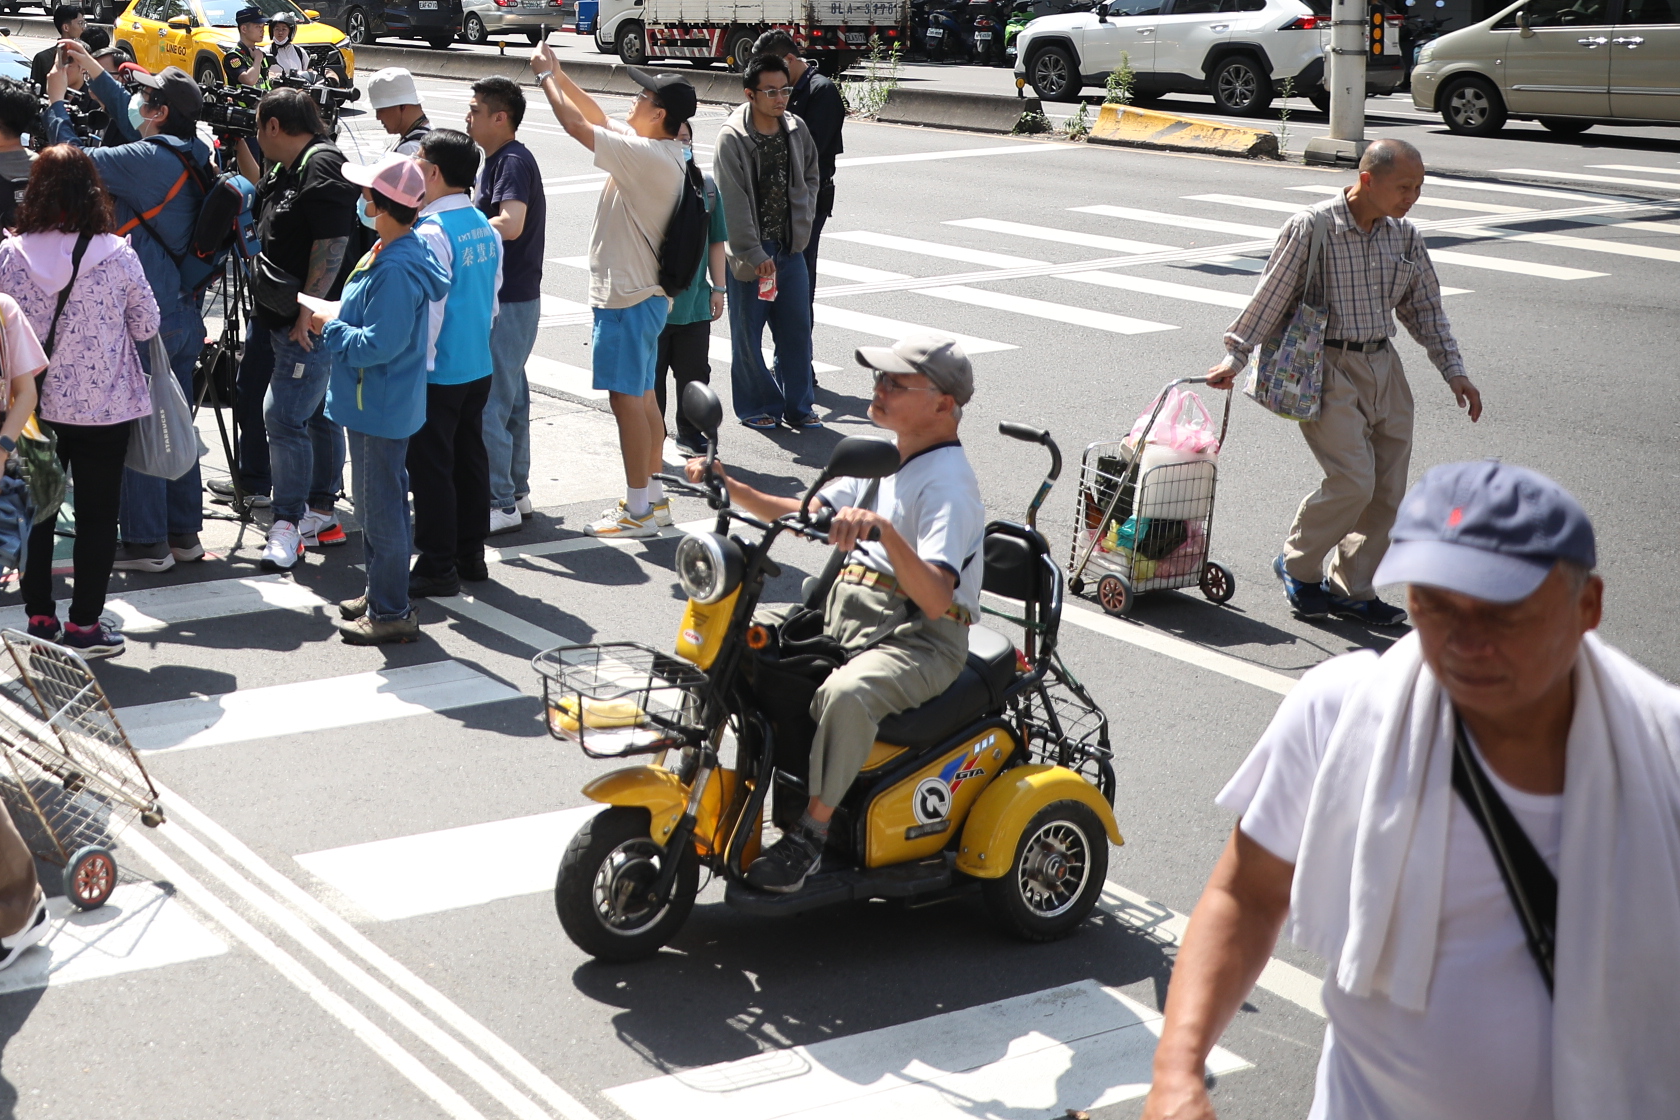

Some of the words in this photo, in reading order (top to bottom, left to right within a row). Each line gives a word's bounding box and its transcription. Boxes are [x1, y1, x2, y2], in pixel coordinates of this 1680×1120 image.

[166, 43, 178, 54] LINE
[178, 45, 187, 56] GO
[160, 409, 171, 453] STARBUCKS
[954, 768, 987, 781] GTA
